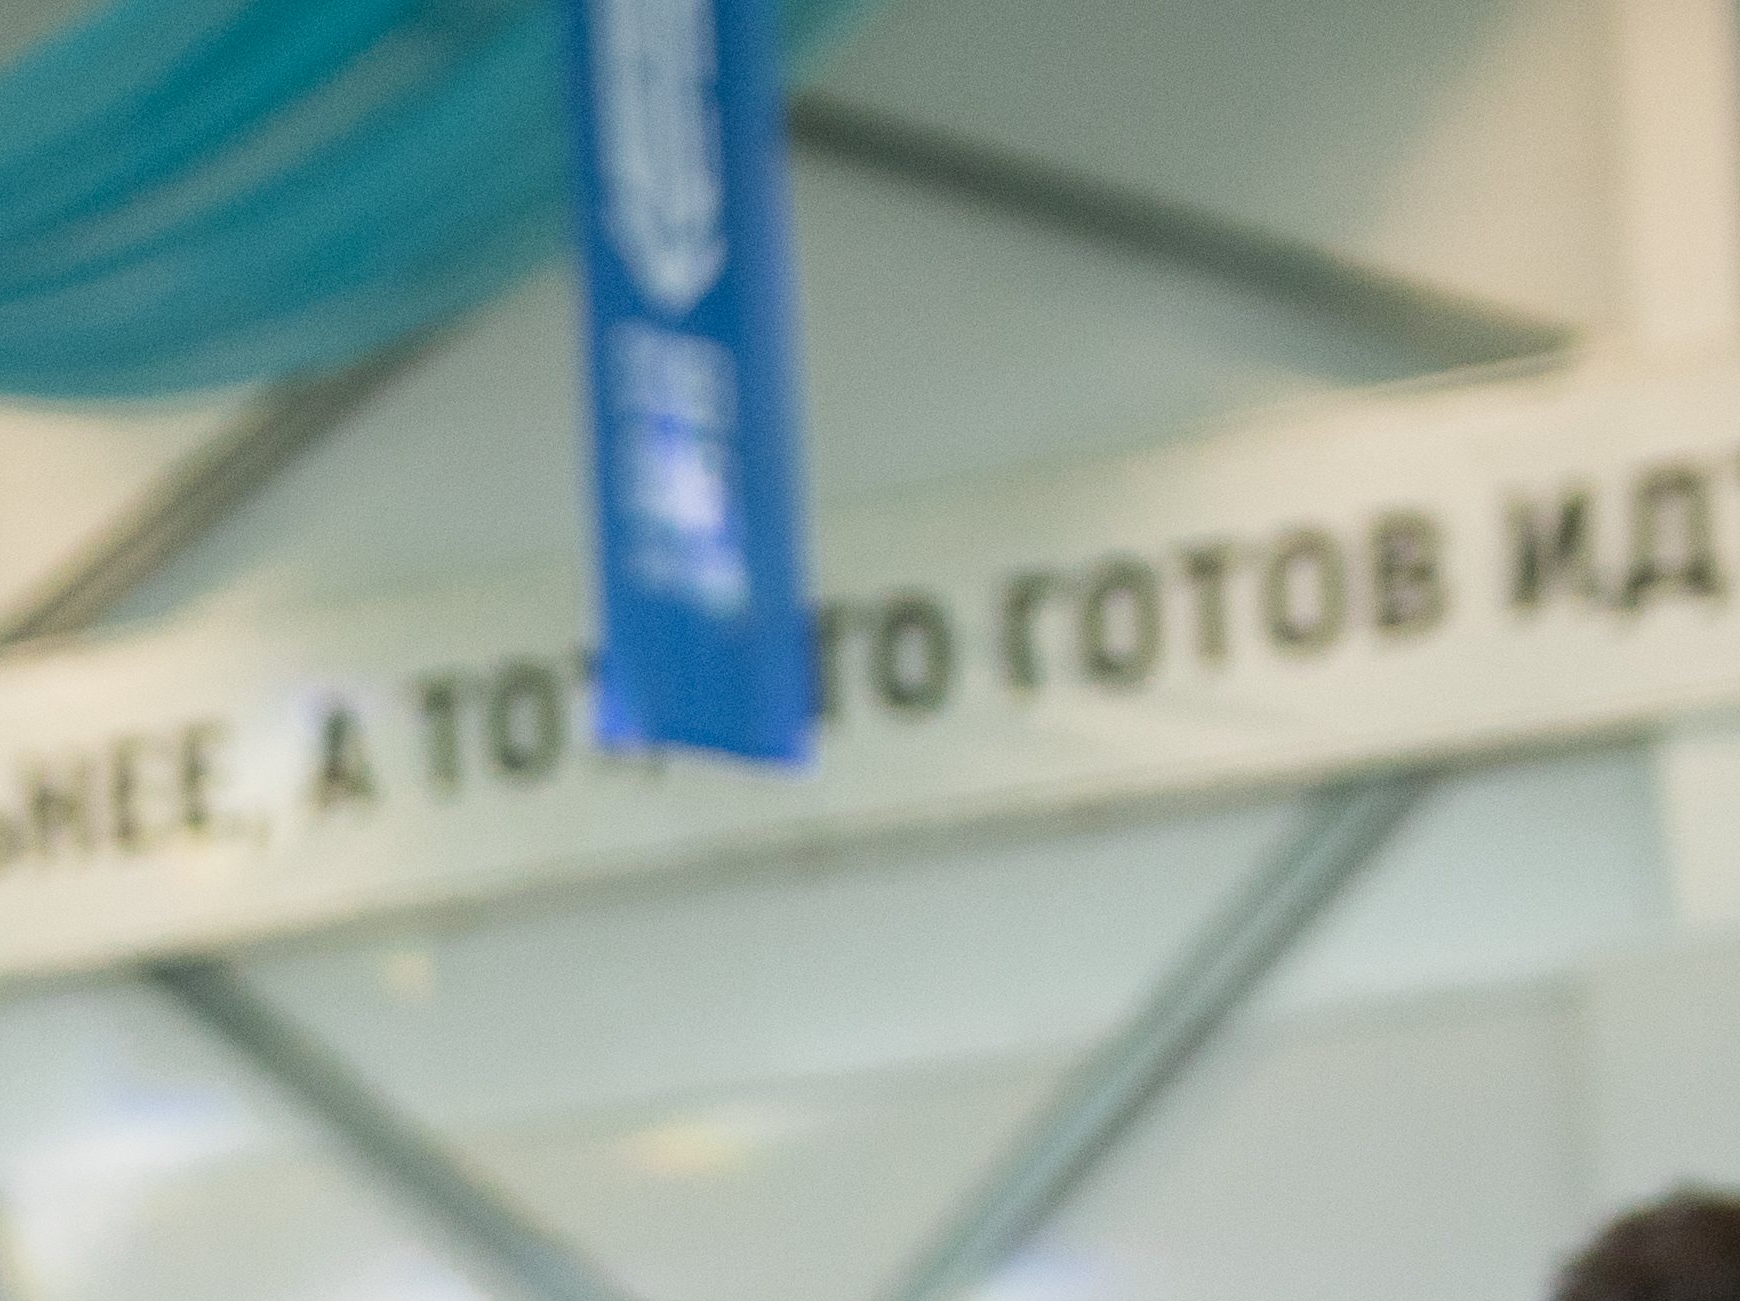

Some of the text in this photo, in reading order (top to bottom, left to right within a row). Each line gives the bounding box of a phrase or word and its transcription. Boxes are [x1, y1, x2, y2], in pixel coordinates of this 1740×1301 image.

[310, 695, 380, 812] А
[995, 505, 1447, 695] ГОТОВ
[1505, 455, 1740, 615] ИД
